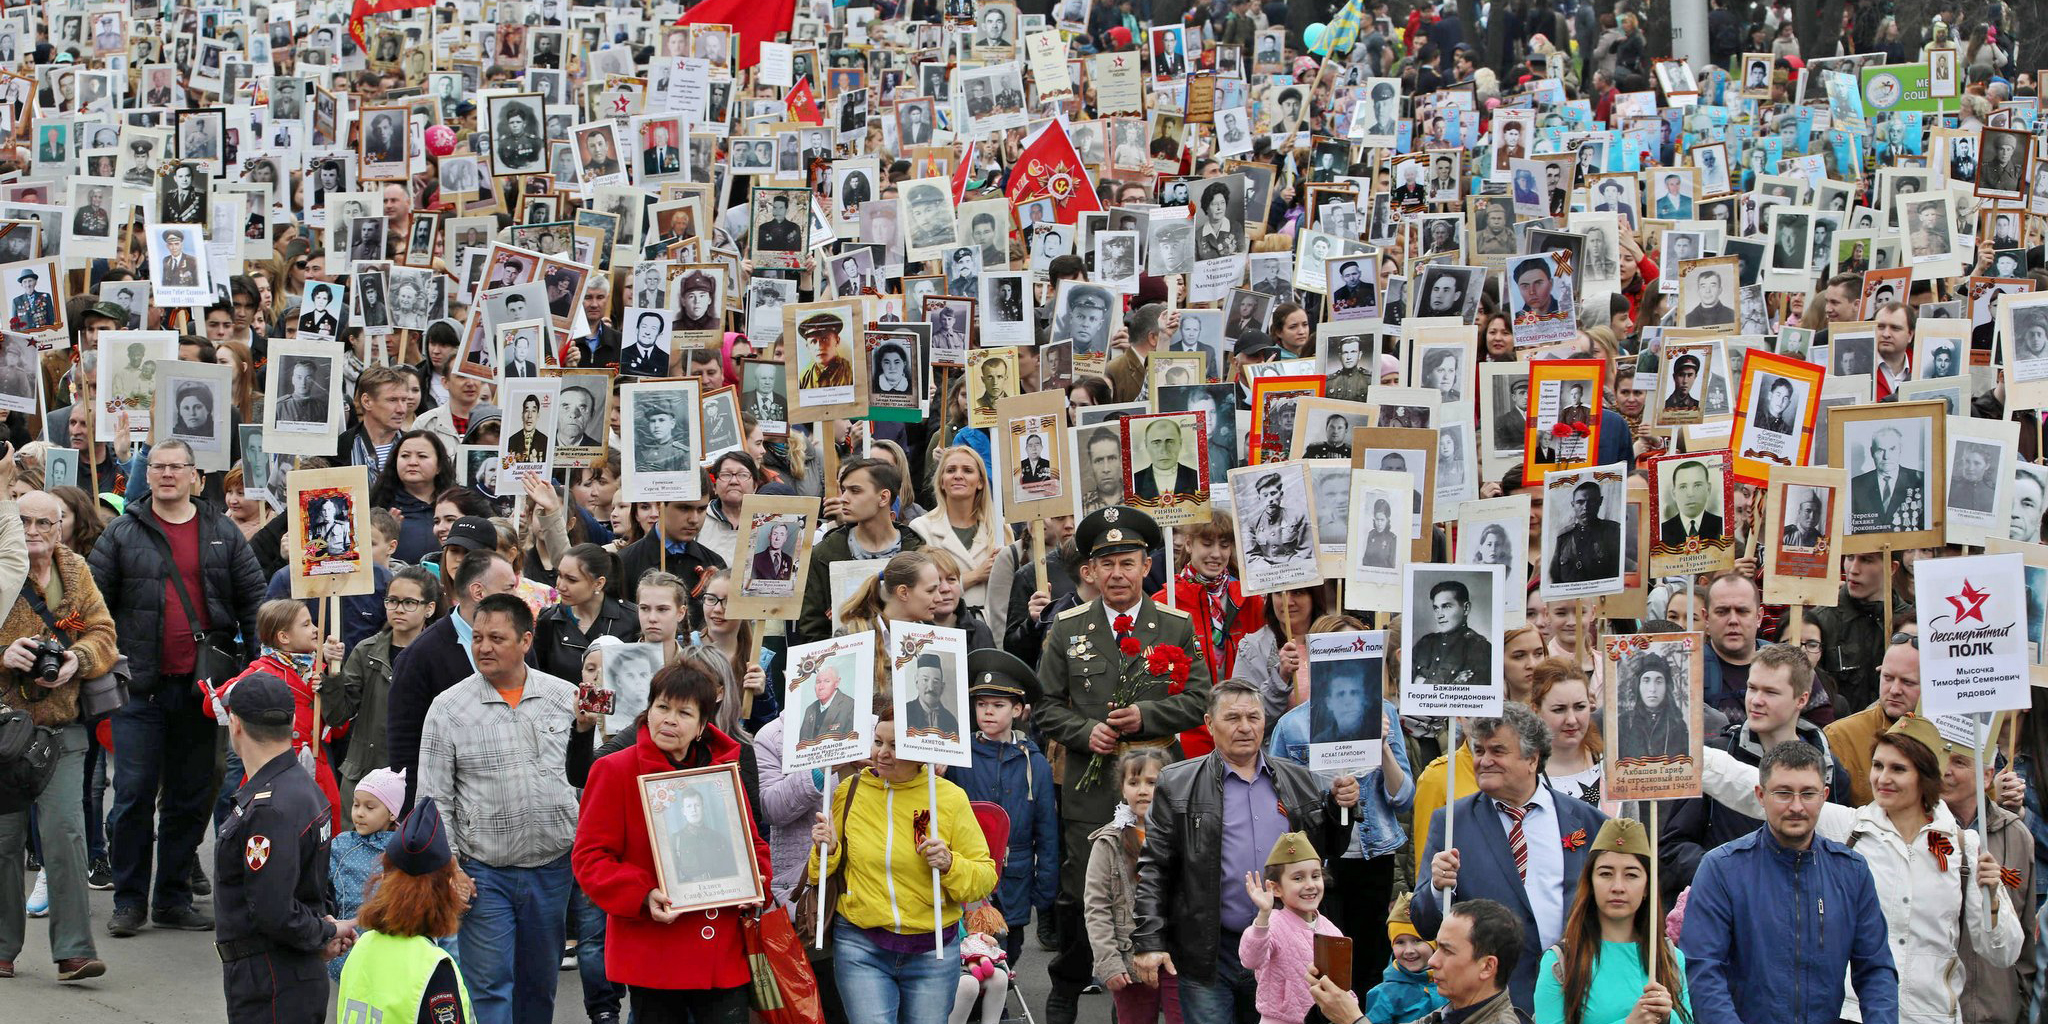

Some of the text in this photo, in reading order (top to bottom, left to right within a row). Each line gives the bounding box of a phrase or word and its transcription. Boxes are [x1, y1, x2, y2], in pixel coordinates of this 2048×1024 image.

[1916, 78, 1929, 88] МЕ
[1154, 507, 1183, 515] РИЯНОВ
[1679, 554, 1707, 562] РИЯНОВ
[1929, 615, 2015, 643] бессмертный
[1949, 641, 1994, 658] ПОЛК
[1956, 666, 1995, 675] Мысочка
[1932, 674, 2020, 687] Тимофей Семенович
[1433, 684, 1470, 692] Бажайкин
[1408, 692, 1496, 701] Георгий Спиридонович
[1957, 687, 1997, 700] рядовой
[1418, 701, 1448, 709] старший
[1935, 717, 1974, 736] Евстигнееви
[921, 738, 945, 746] АХМЕТОВ
[811, 742, 843, 752] АРСЛАНОВ
[1622, 766, 1684, 776] Акбашев Гариф
[1627, 775, 1673, 784] стрелковый
[1612, 785, 1628, 793] 1901
[1639, 784, 1671, 793] февраля
